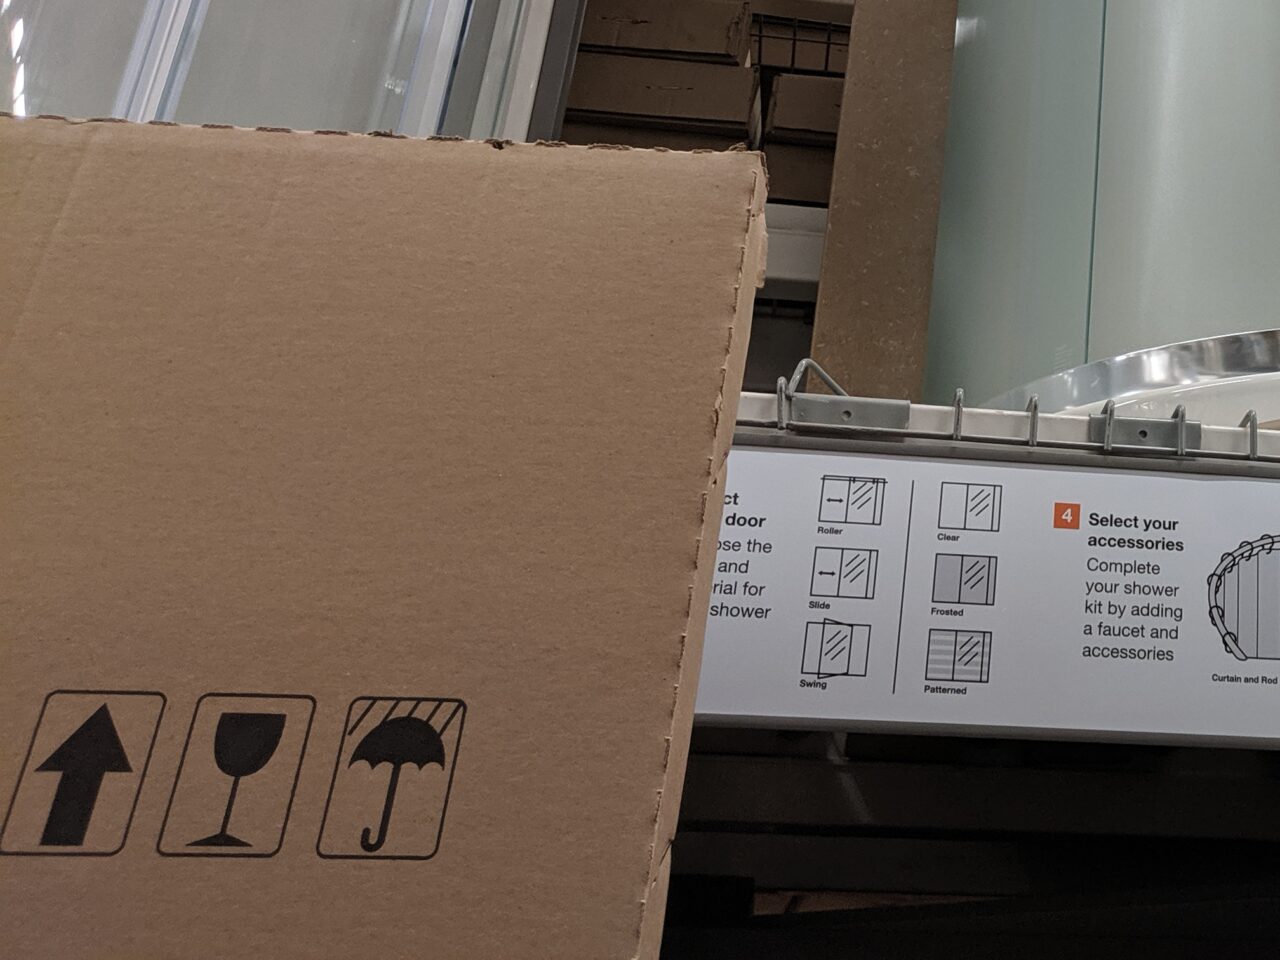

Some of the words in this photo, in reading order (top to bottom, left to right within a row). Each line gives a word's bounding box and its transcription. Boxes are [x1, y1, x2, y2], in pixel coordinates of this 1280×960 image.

[725, 512, 766, 528] door
[1061, 508, 1073, 523] 4
[1088, 512, 1139, 528] Select
[1143, 518, 1179, 532] your
[817, 526, 843, 535] Roller
[937, 533, 960, 542] Clear
[747, 539, 772, 553] the
[1087, 535, 1184, 552] accessories
[717, 560, 750, 574] and
[1086, 557, 1161, 576] Complete
[743, 581, 765, 596] for
[1085, 581, 1120, 596] your
[1124, 581, 1180, 597] shower
[709, 602, 772, 619] shower
[808, 600, 831, 610] Slide
[930, 607, 964, 617] Frosted
[1084, 599, 1103, 614] kit
[1107, 601, 1126, 619] by
[1130, 602, 1183, 622] adding
[1083, 623, 1093, 636] a
[1097, 621, 1145, 638] faucet
[1150, 625, 1179, 640] and
[1082, 645, 1174, 661] accessories
[799, 679, 827, 690] Swing
[1211, 673, 1242, 685] Curtain
[1243, 675, 1258, 685] and
[1260, 675, 1278, 685] Rod
[924, 684, 967, 695] Patterned
